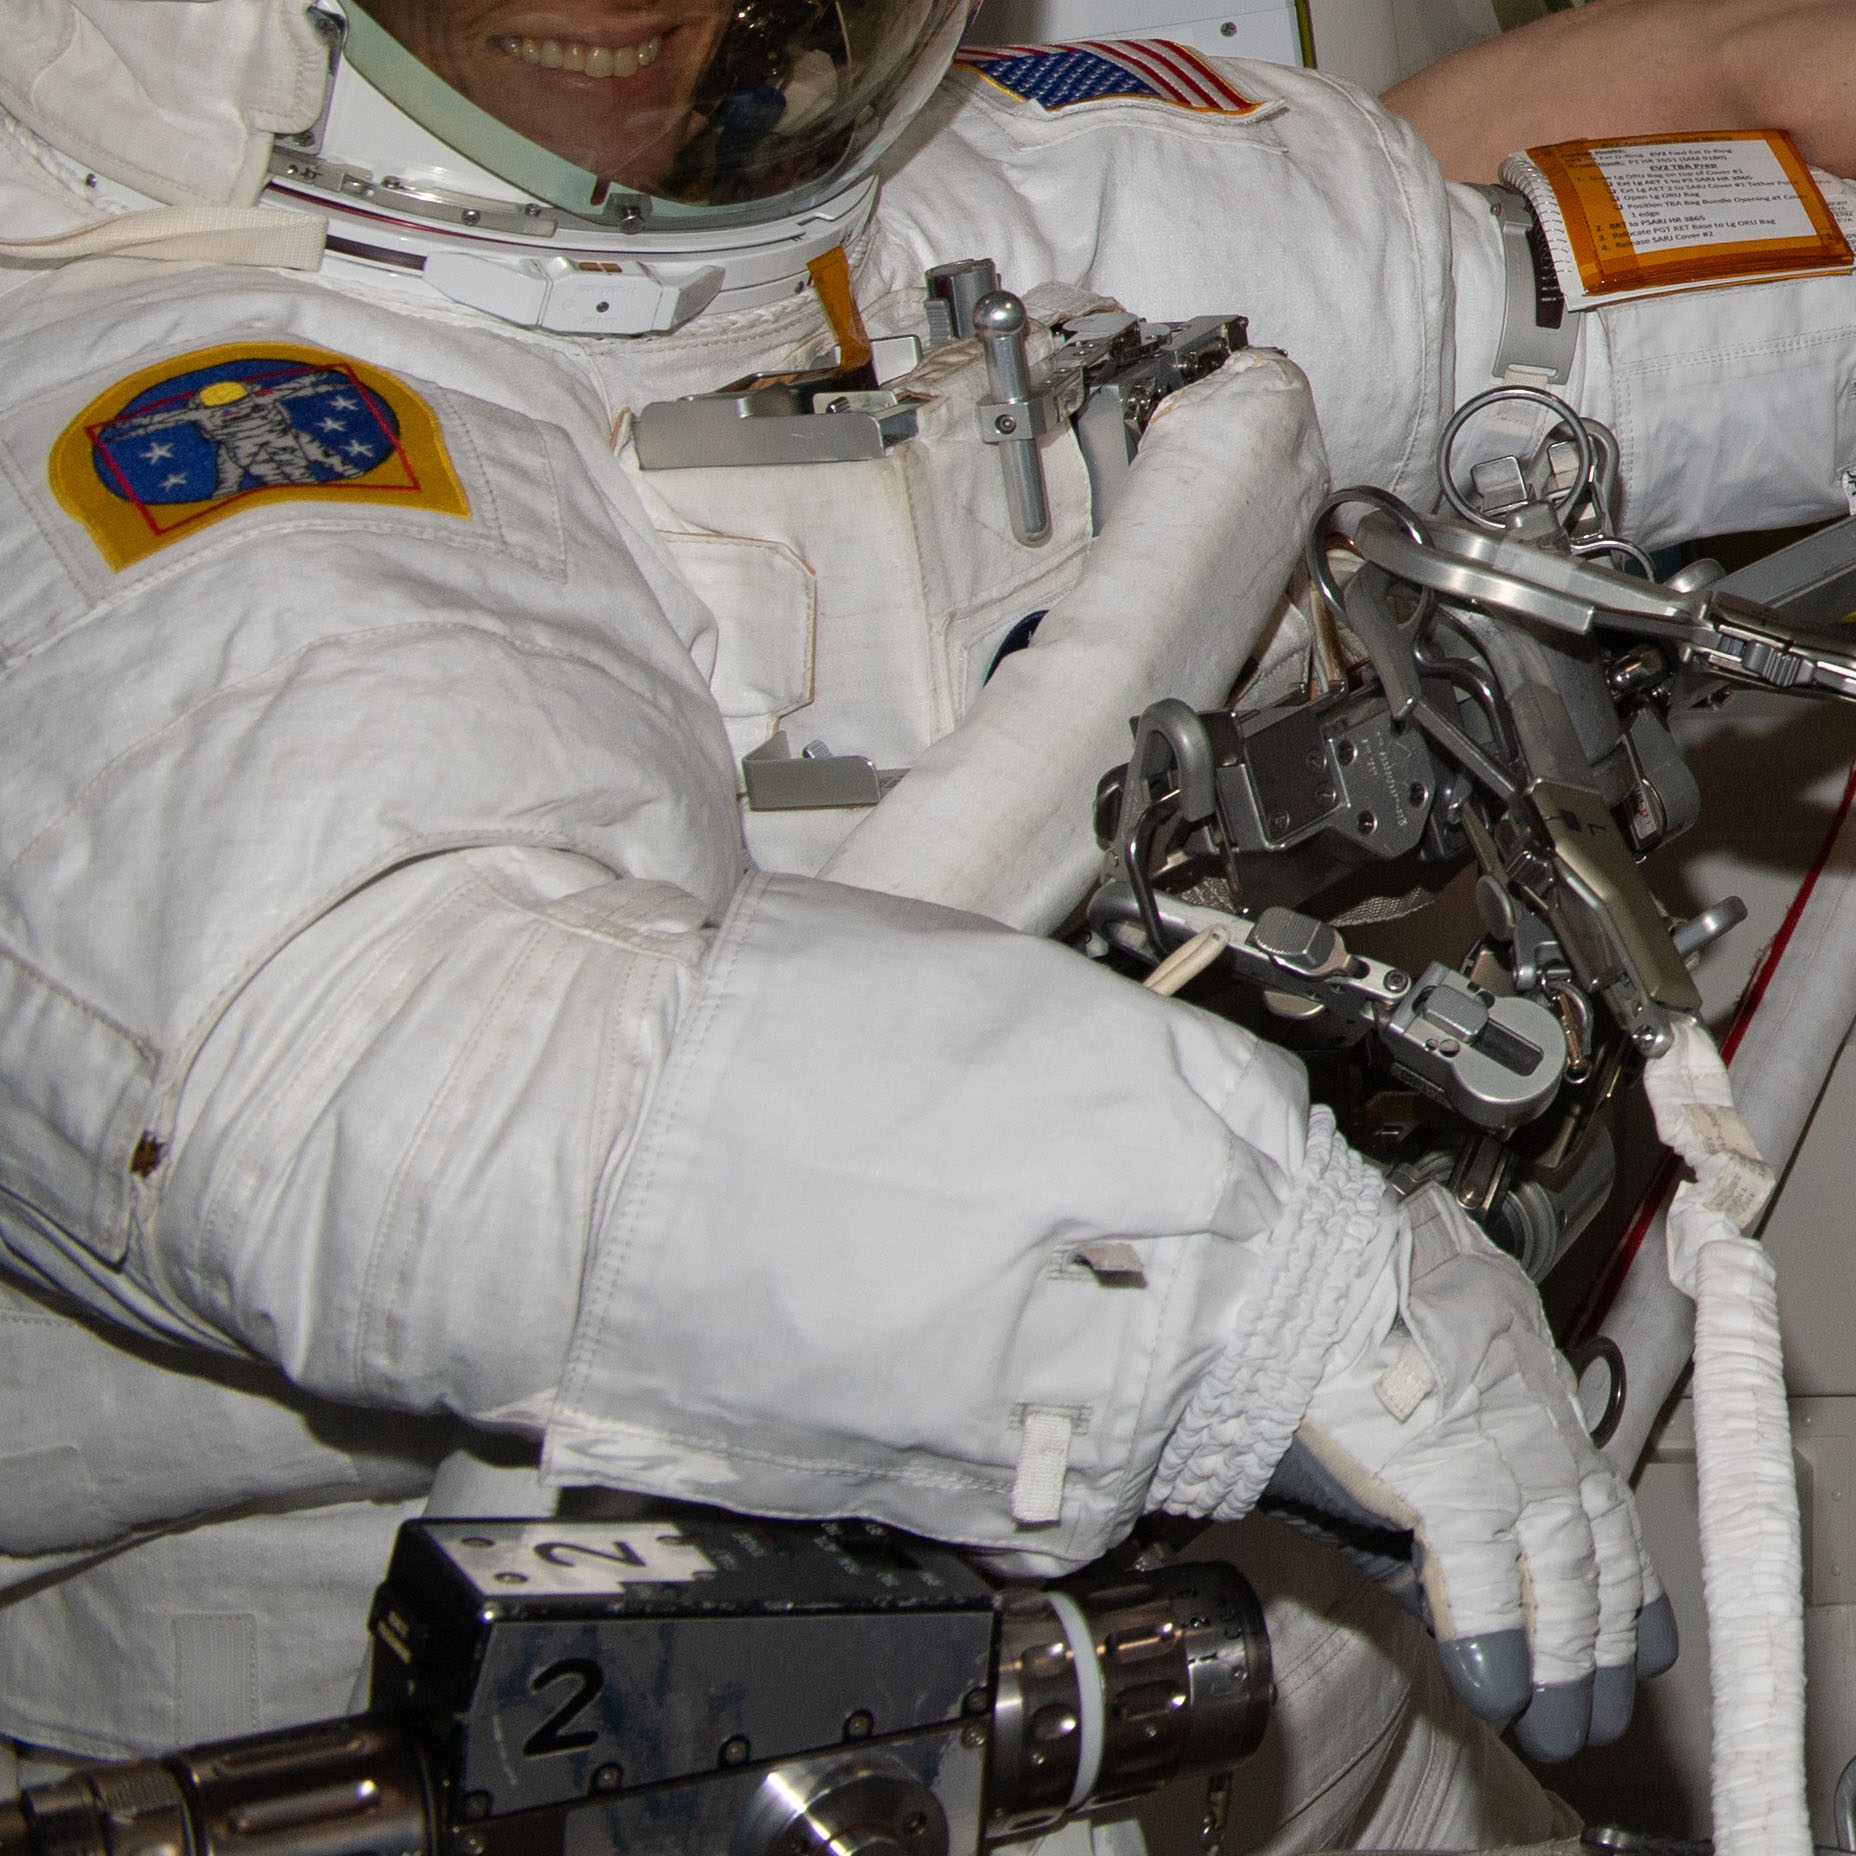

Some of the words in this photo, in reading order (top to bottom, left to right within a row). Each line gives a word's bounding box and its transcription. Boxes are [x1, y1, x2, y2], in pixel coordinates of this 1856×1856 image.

[1628, 202, 1662, 210] Position
[1734, 196, 1770, 204] Opening
[1638, 211, 1660, 219] edge
[536, 1539, 647, 1573] 2
[524, 1657, 605, 1759] 2
